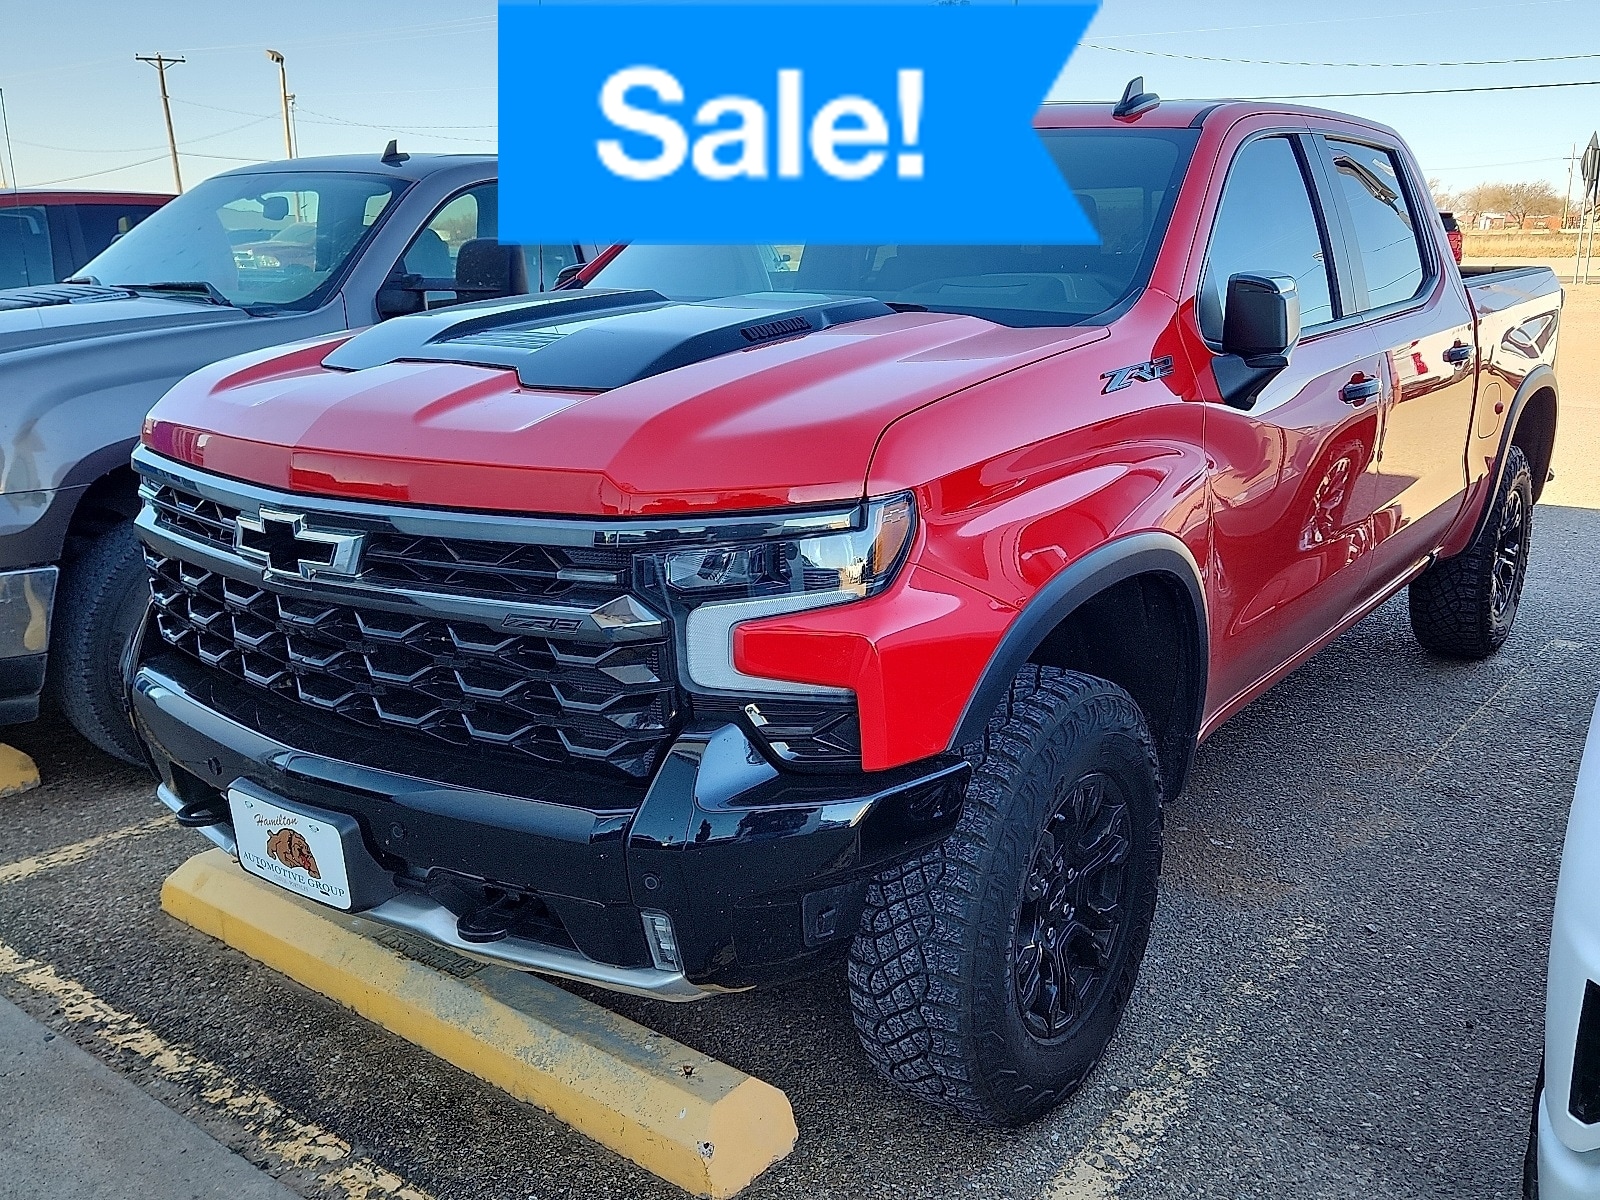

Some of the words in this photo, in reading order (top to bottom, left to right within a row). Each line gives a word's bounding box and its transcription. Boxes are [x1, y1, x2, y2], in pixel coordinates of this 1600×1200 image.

[1099, 355, 1175, 395] ZR2
[253, 813, 299, 827] Hamilton
[243, 851, 306, 885] AUTOMOTIVE
[307, 878, 345, 897] GROUP
